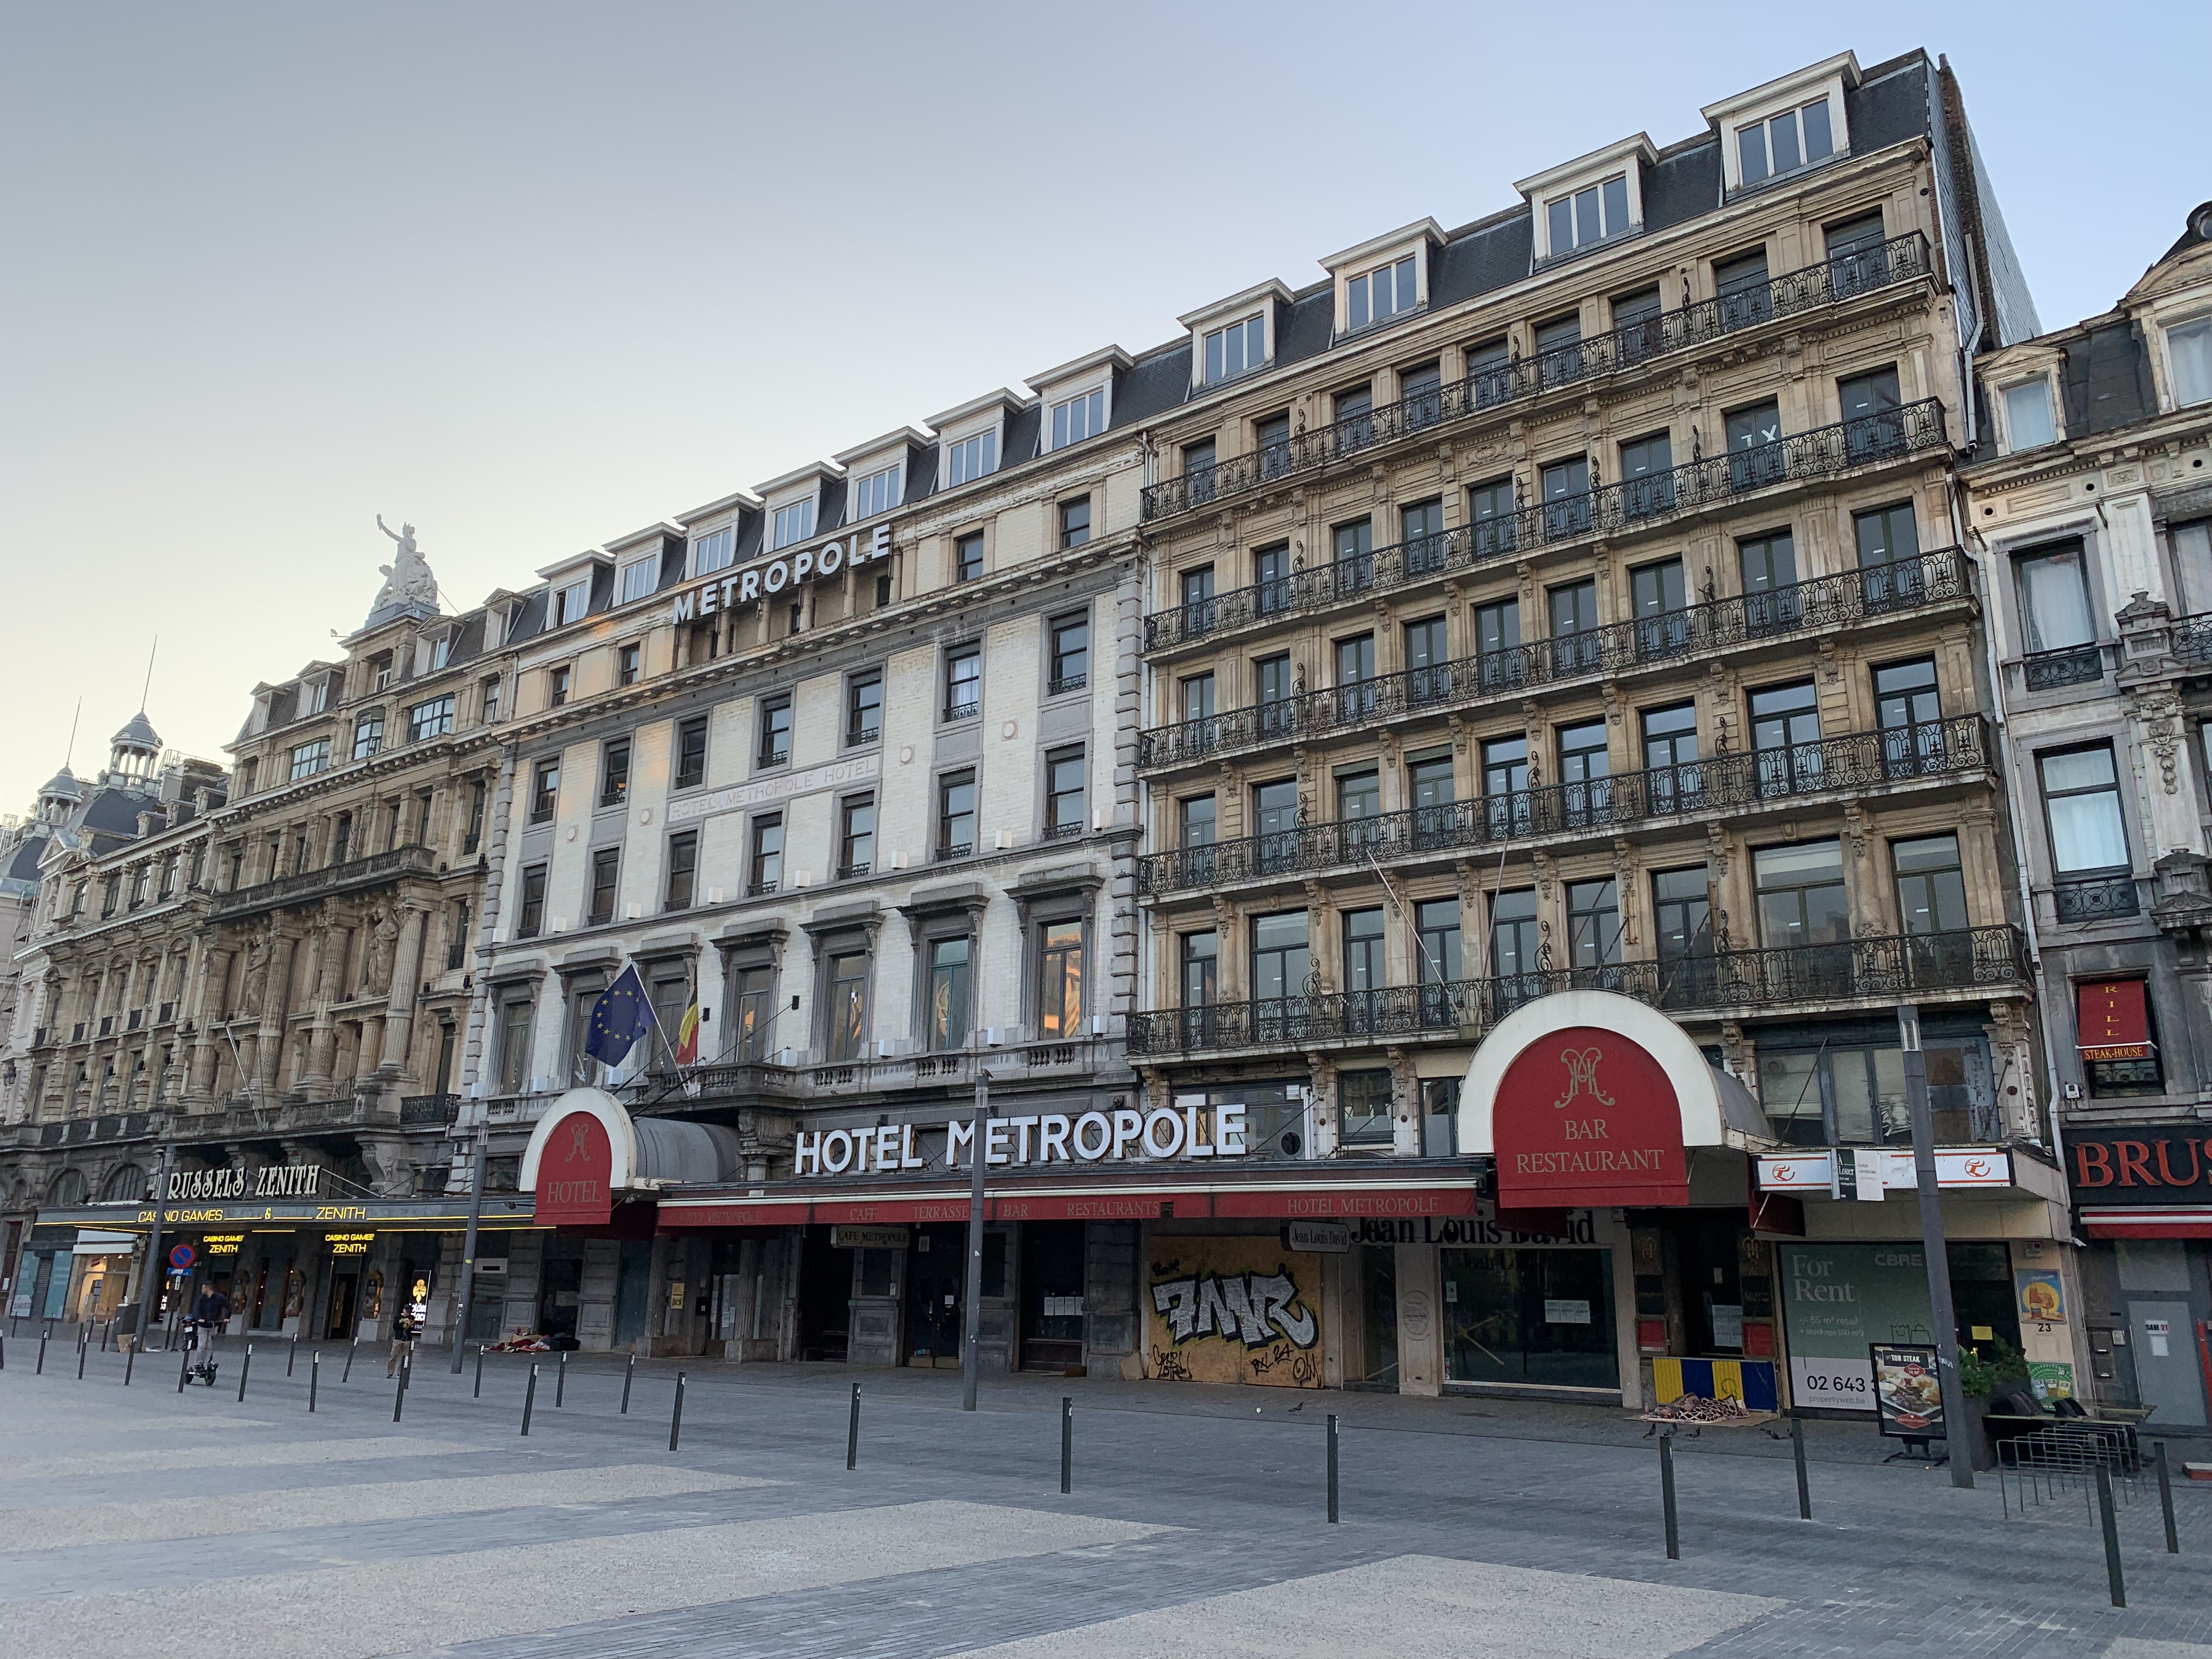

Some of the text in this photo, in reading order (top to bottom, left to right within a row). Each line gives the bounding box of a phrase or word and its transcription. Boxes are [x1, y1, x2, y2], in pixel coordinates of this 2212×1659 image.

[673, 523, 890, 625] METROPOLE
[672, 760, 875, 818] HOTEL METROPOLE HOTEL
[2085, 1046, 2143, 1060] STEAK-HOUSE
[1564, 1119, 1610, 1140] BAR
[795, 1104, 1249, 1175] HOTEL METROPOLE
[1516, 1149, 1664, 1174] RESTAURANT
[1838, 1166, 1854, 1175] Louer
[2070, 1138, 2211, 1187] BRU
[255, 1165, 320, 1197] ZENITH
[546, 1180, 601, 1204] HOTEL
[138, 1207, 366, 1222] CASNO GAMES & ZENITH
[913, 1205, 969, 1219] TERRASSE
[1003, 1204, 1029, 1217] BAR
[1067, 1200, 1160, 1217] RESTAURANTS
[1287, 1197, 1440, 1214] HOTEL METROPOLE
[1351, 1216, 1417, 1243] Jean
[1425, 1210, 1502, 1244] Louis
[1293, 1228, 1347, 1245] Jean Louis David
[209, 1245, 238, 1253] ZENITH
[332, 1244, 366, 1253] ZENITH
[1792, 1255, 1834, 1277] For
[1874, 1254, 1923, 1267] CBRE
[1793, 1279, 1856, 1302] Rent
[2038, 1323, 2051, 1333] 23
[1903, 1355, 1920, 1363] STEAK
[1807, 1375, 1828, 1390] 02
[1833, 1376, 1865, 1392] 643
[1809, 1395, 1866, 1404] propertyweb.be
